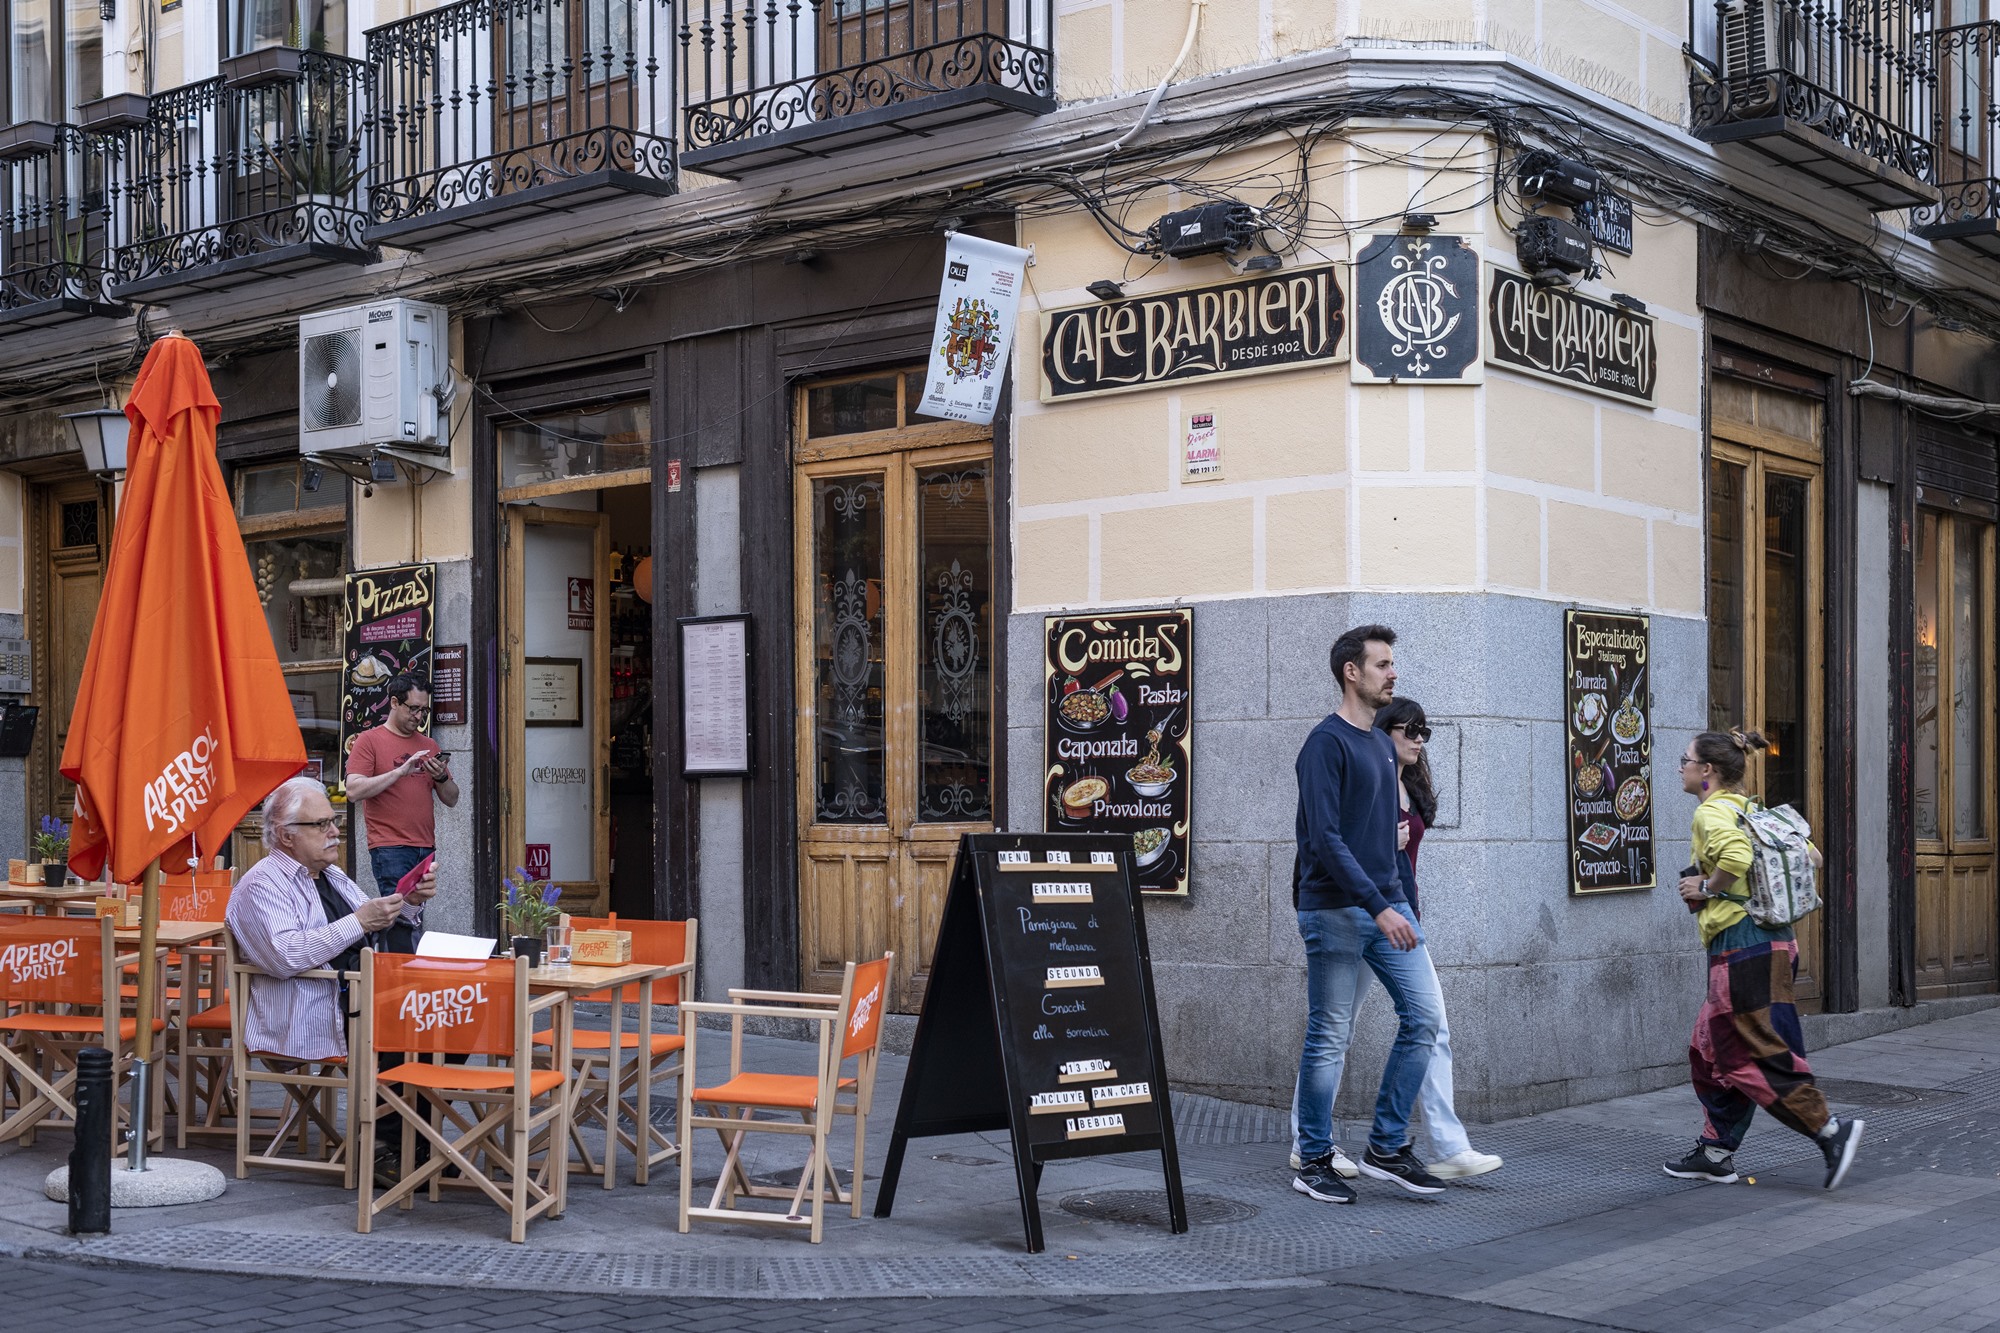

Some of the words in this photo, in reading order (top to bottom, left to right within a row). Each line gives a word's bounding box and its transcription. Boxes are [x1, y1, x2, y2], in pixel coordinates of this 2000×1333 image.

[949, 266, 967, 277] CALLE
[1142, 273, 1327, 381] BARBIERI
[1232, 346, 1269, 361] DESDE
[1271, 340, 1301, 356] 1902
[1551, 293, 1650, 395] BARBIERI
[1600, 367, 1620, 384] DESDE
[1621, 374, 1636, 389] 1902
[1190, 467, 1200, 475] 902
[1201, 466, 1210, 474] 121
[356, 567, 429, 623] Pizzas
[1059, 623, 1182, 673] Comidas
[1576, 624, 1646, 664] Especialidades
[1576, 670, 1607, 690] Burrata
[1138, 682, 1181, 704] Pasta
[1058, 732, 1138, 764] Caponata
[1613, 743, 1640, 767] Pasta
[144, 725, 218, 832] APEROL
[1094, 799, 1172, 817] Provolone
[1575, 798, 1612, 823] Caponata
[1620, 823, 1649, 847] Pizzas
[529, 849, 548, 867] AD
[999, 852, 1029, 862] MENU
[1048, 852, 1069, 863] DEL
[1093, 853, 1113, 863] DIA
[1579, 857, 1620, 884] Carpaccio
[1034, 884, 1090, 895] ENTRANTE
[169, 889, 216, 919] APEROL
[1016, 906, 1078, 934] Parmigiana
[1088, 914, 1099, 928] di
[0, 938, 78, 972] APEROL
[578, 941, 609, 954] APEROL
[1050, 937, 1097, 952] melanzana
[1049, 966, 1099, 979] SEGUNDO
[400, 983, 488, 1020] APEROL
[1041, 993, 1087, 1016] Gnocchi
[1032, 1024, 1054, 1040] alla
[1066, 1027, 1110, 1038] sorrentina
[1080, 1115, 1122, 1129] BEBIDA
